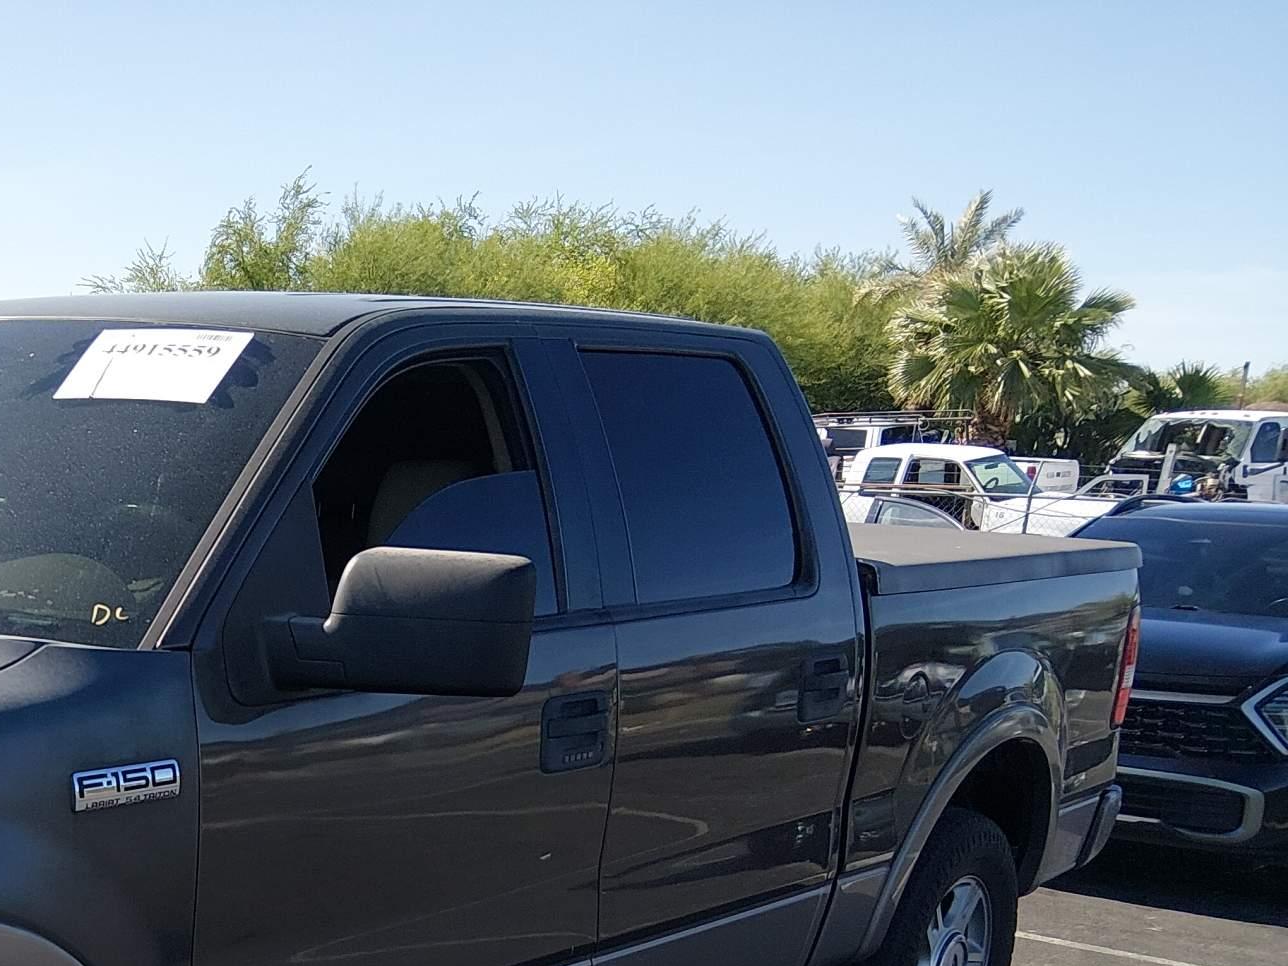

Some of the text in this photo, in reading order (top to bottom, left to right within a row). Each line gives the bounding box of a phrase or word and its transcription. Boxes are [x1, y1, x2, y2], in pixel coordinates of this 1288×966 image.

[102, 343, 221, 358] 44915559
[85, 797, 121, 810] LARIAT
[143, 789, 178, 801] TRITON
